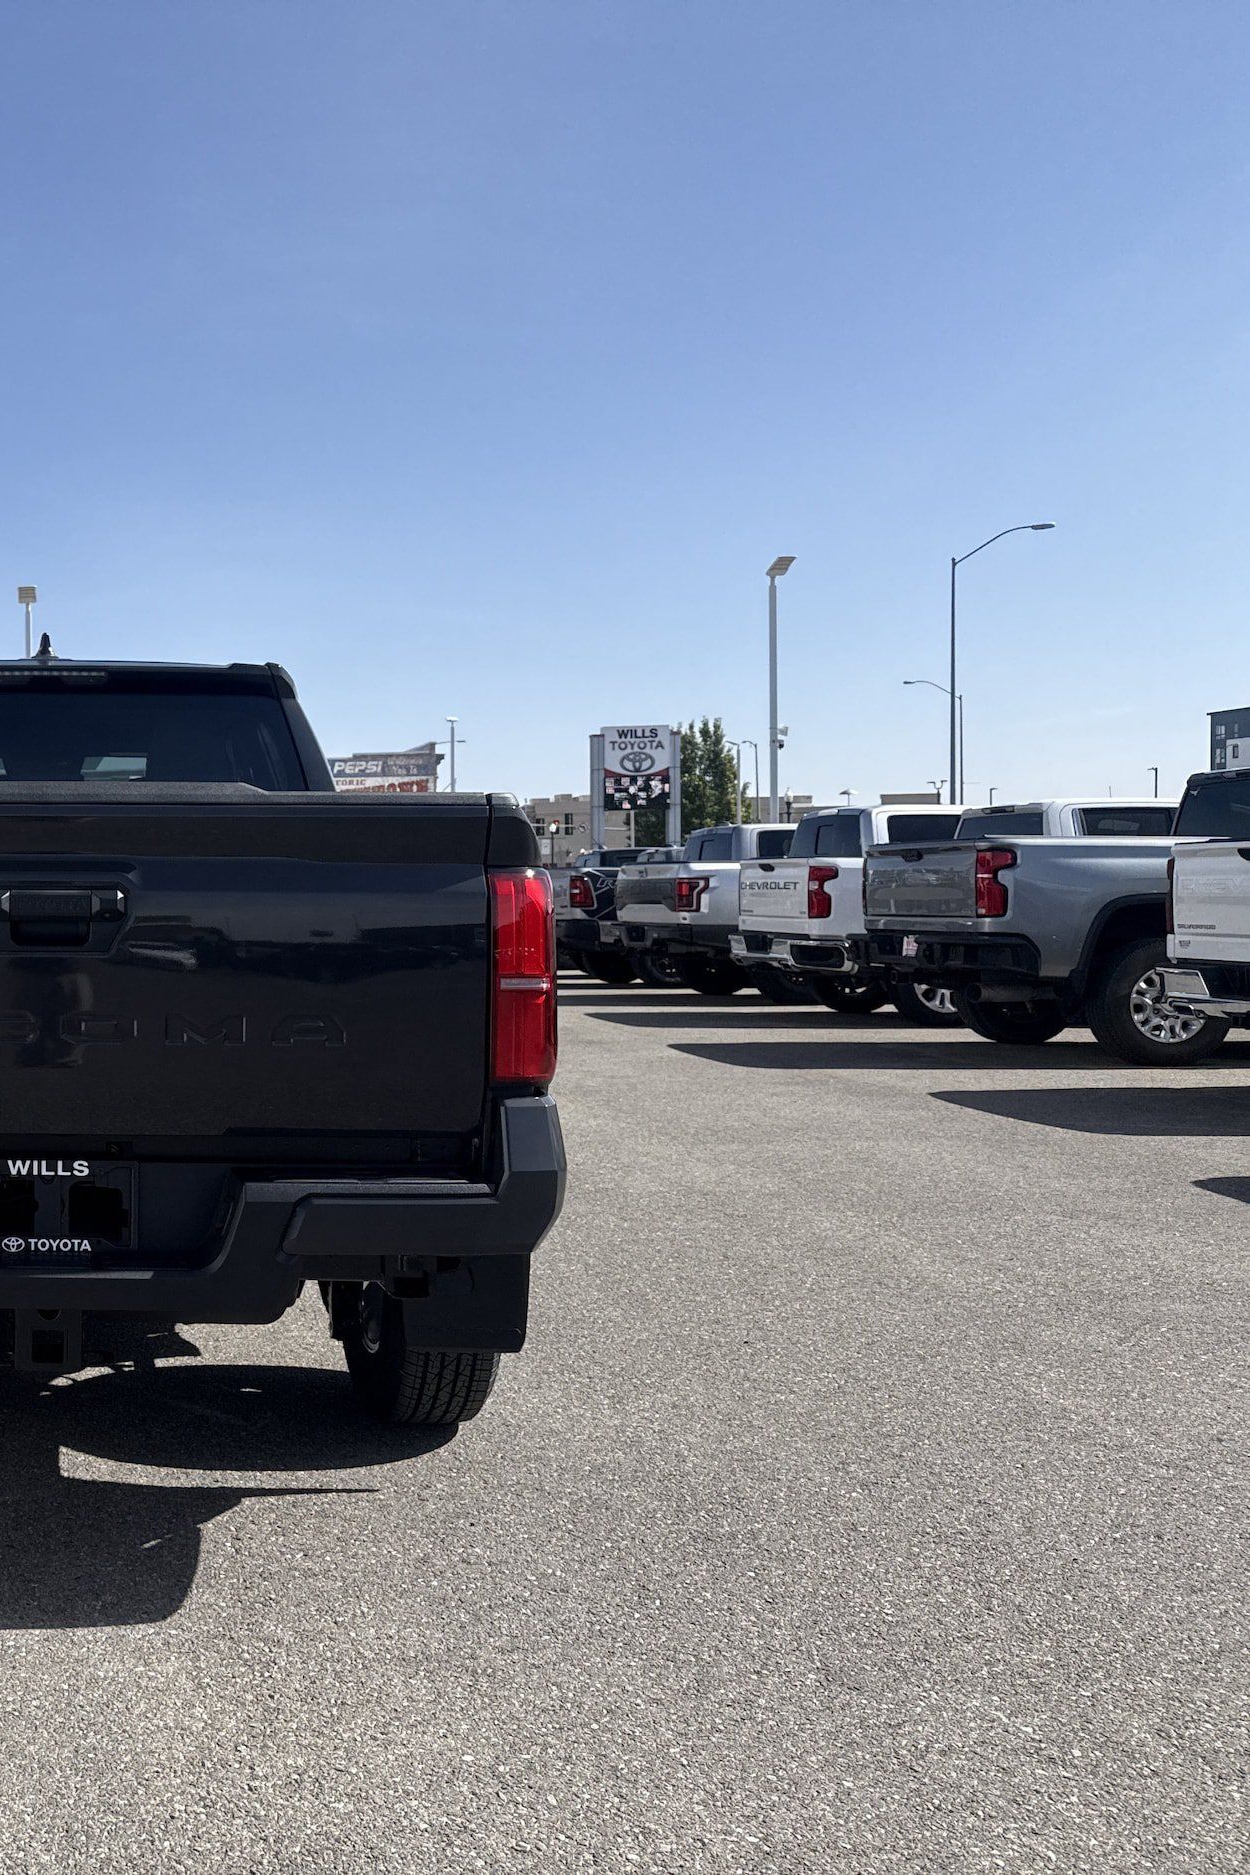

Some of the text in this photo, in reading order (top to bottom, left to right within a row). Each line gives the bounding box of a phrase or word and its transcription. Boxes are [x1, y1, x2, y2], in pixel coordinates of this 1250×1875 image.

[617, 728, 658, 739] WILLS
[609, 740, 665, 751] TOYOTA
[333, 761, 383, 774] PEPSI
[740, 881, 799, 890] CHEVROLET
[7, 1160, 90, 1177] WILLS
[28, 1239, 92, 1252] TOYOTA
